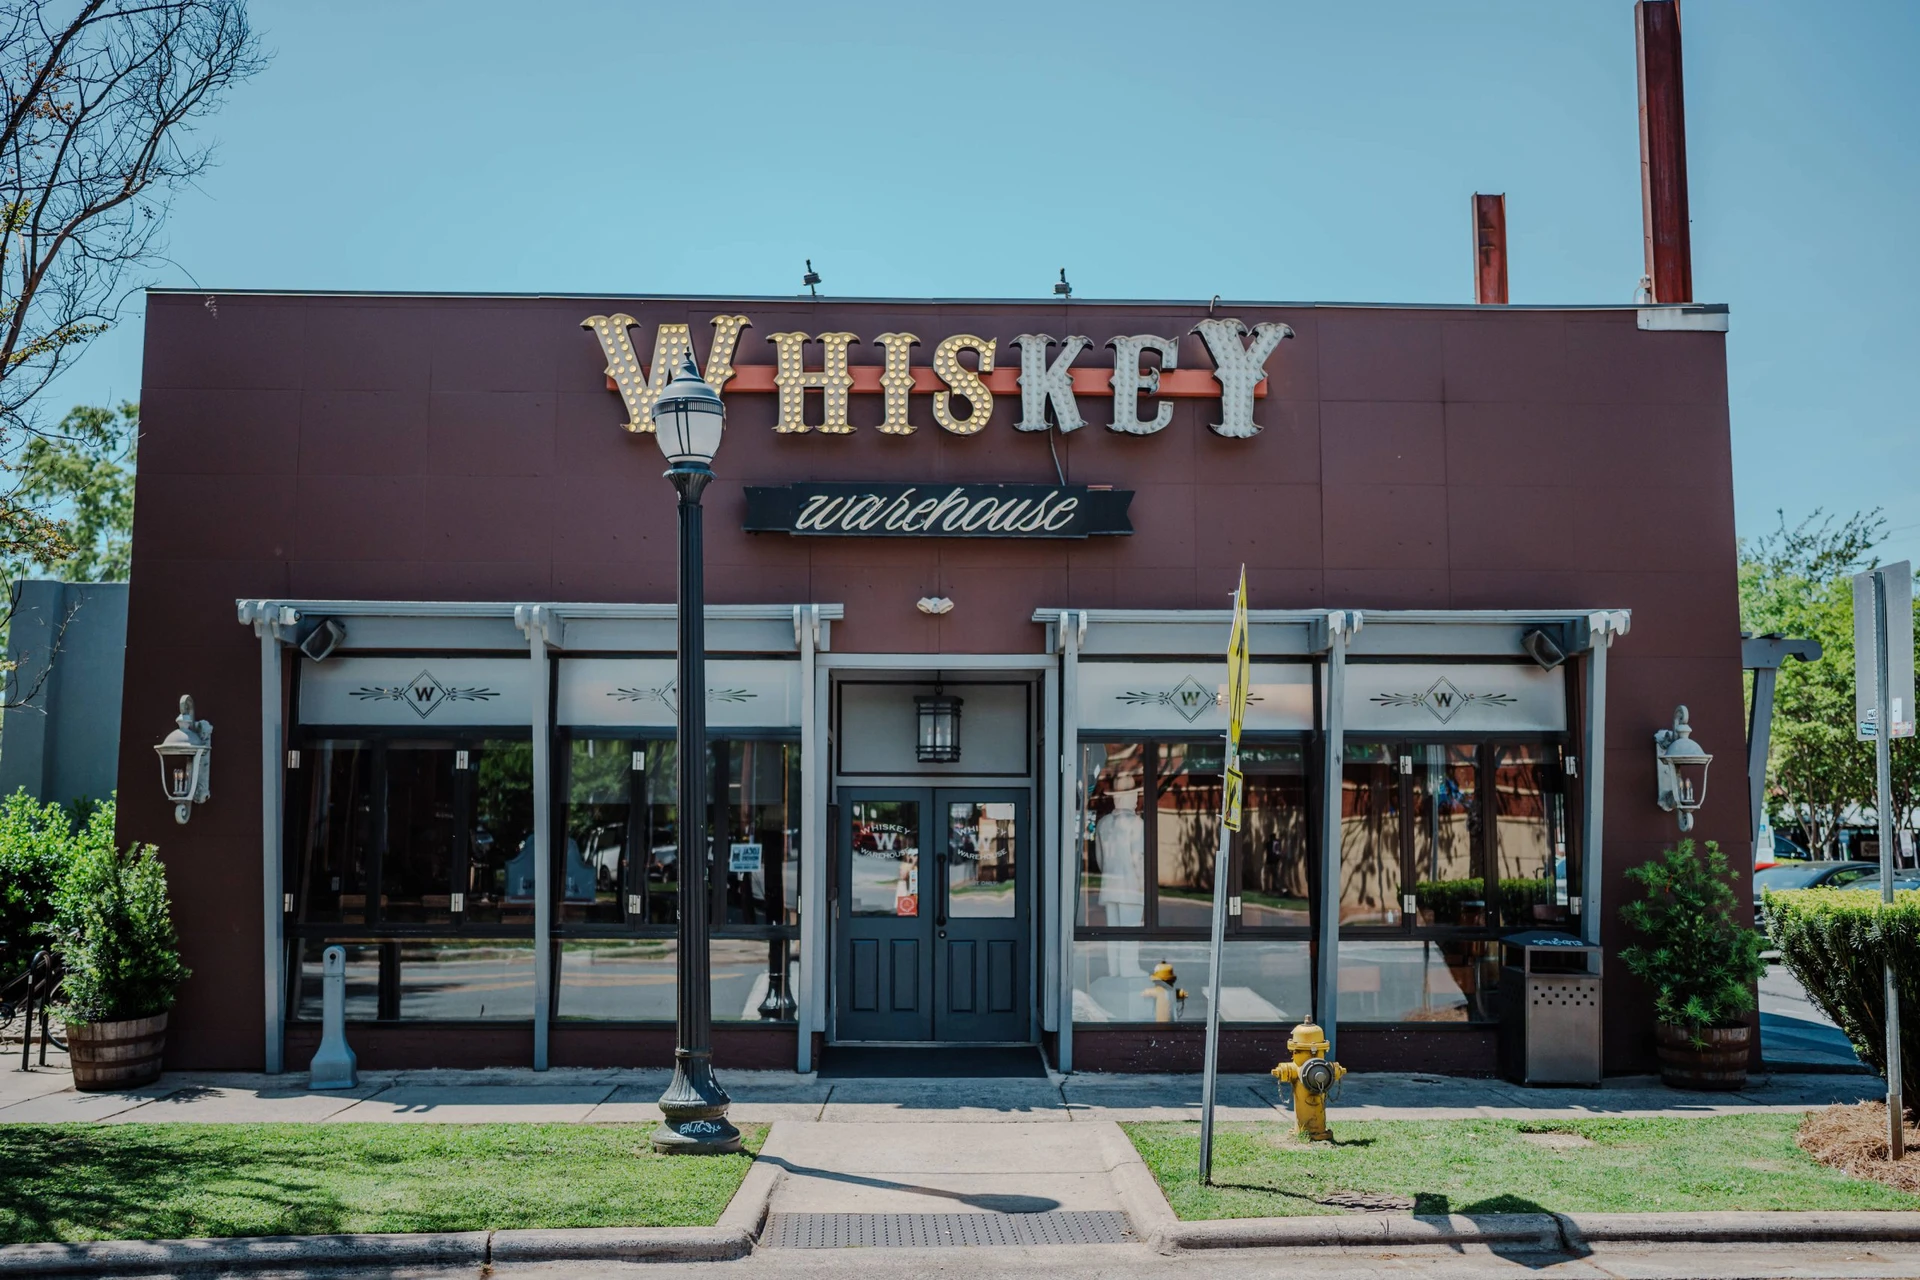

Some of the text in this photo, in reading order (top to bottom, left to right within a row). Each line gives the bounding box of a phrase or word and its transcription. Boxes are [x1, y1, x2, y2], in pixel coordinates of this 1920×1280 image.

[580, 312, 1296, 439] WHISKEY
[796, 486, 1080, 532] warehouse
[414, 687, 436, 702] W
[1181, 691, 1201, 707] W
[1433, 692, 1454, 708] W
[860, 823, 911, 835] WHISKEY
[956, 825, 1007, 836] WHIY
[872, 832, 898, 851] W
[968, 833, 993, 852] W
[957, 847, 1008, 860] WAREHOUSE
